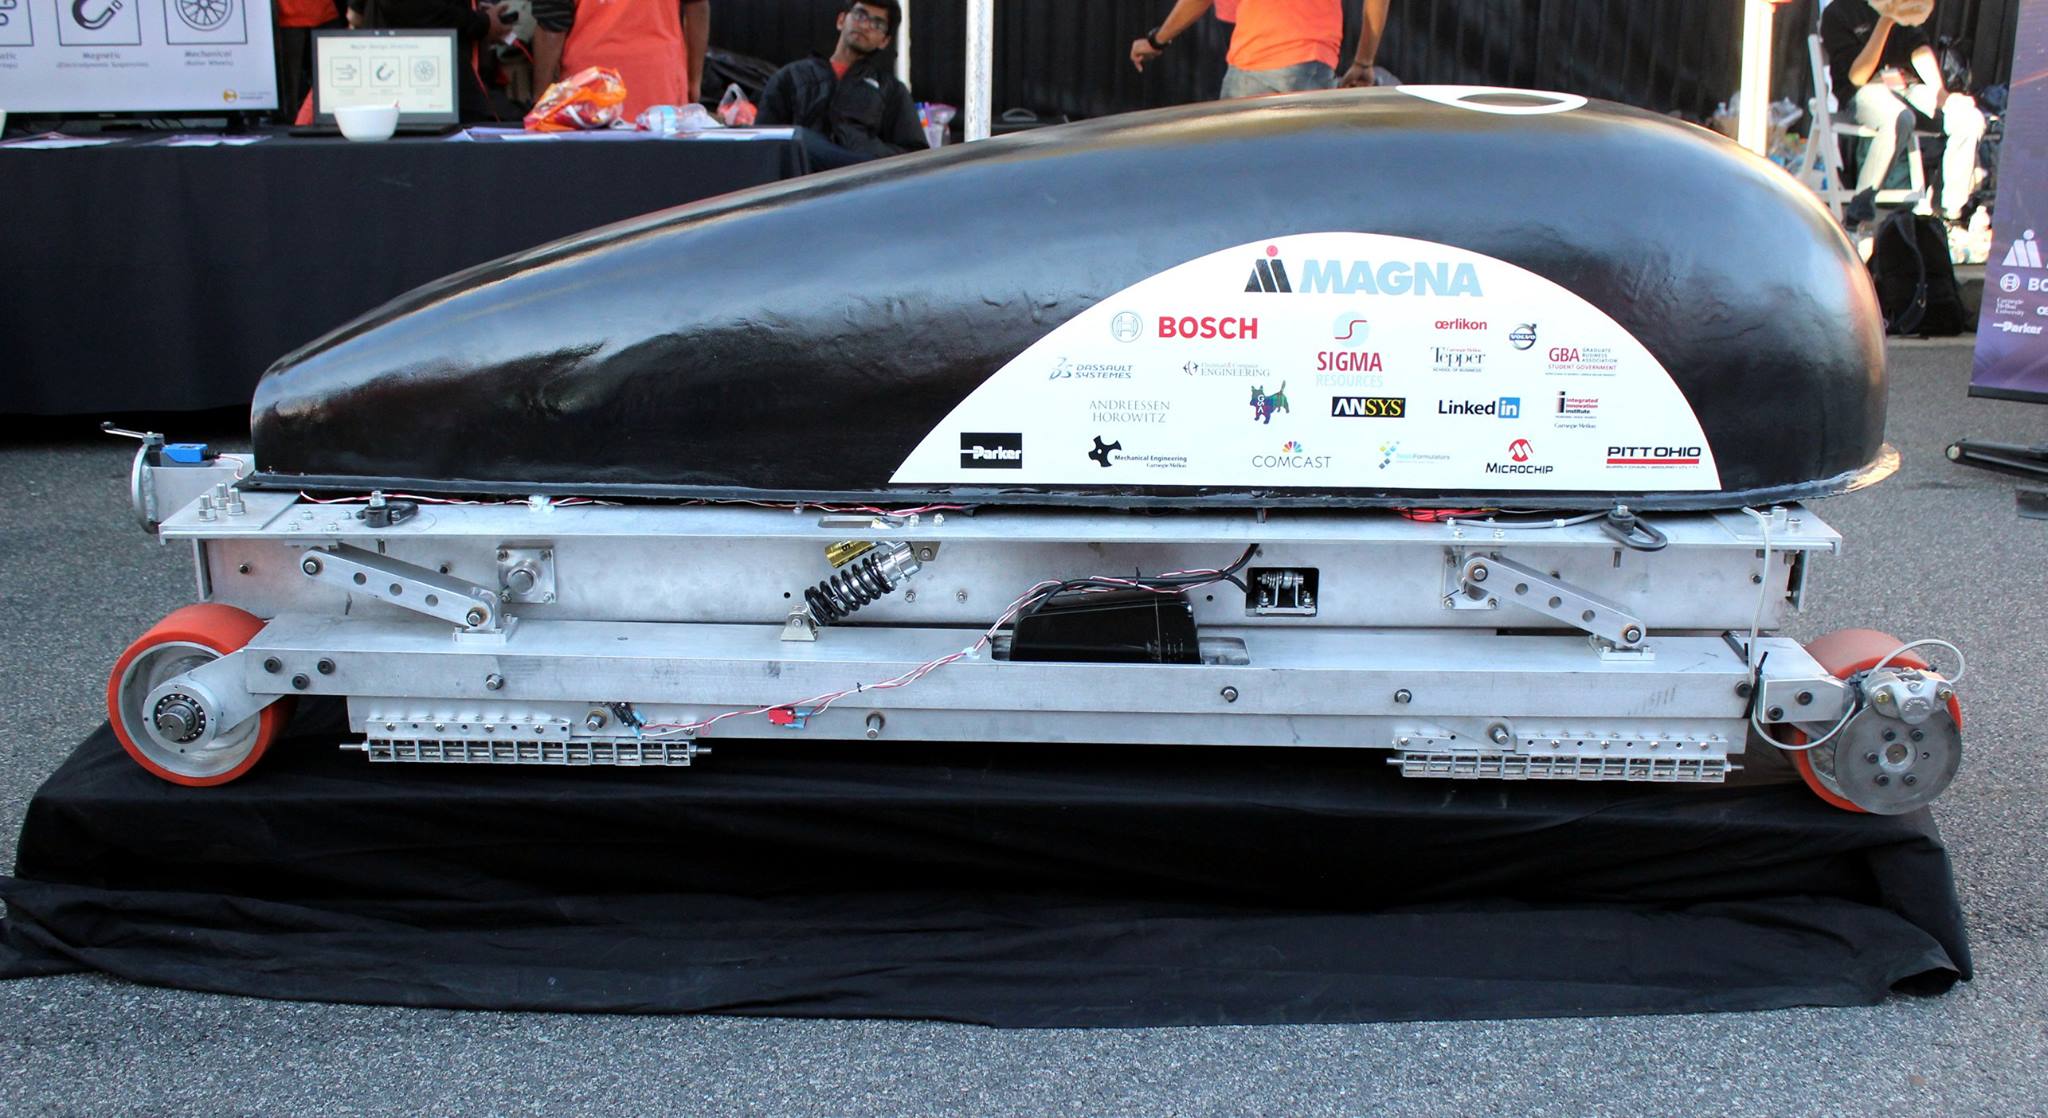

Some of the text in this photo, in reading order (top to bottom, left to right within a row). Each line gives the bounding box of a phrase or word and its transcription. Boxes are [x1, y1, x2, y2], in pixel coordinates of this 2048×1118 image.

[1300, 259, 1483, 297] MAGNA
[1159, 316, 1258, 339] BOSCH
[2003, 321, 2042, 334] Parker
[1317, 351, 1382, 372] SIGMA
[1430, 347, 1486, 367] Tepper
[1549, 348, 1579, 362] GBA
[1201, 368, 1270, 377] ENGINEERING
[1316, 374, 1383, 388] RESOURCES
[1090, 400, 1170, 410] ANDREESSEN
[1334, 398, 1402, 415] ANSYS
[1093, 412, 1166, 423] HOROWITZ
[973, 446, 1021, 459] Parker
[1608, 447, 1701, 457] PITT OHIO
[1252, 456, 1331, 468] COMCAST
[1486, 462, 1553, 474] MICROCHIP
